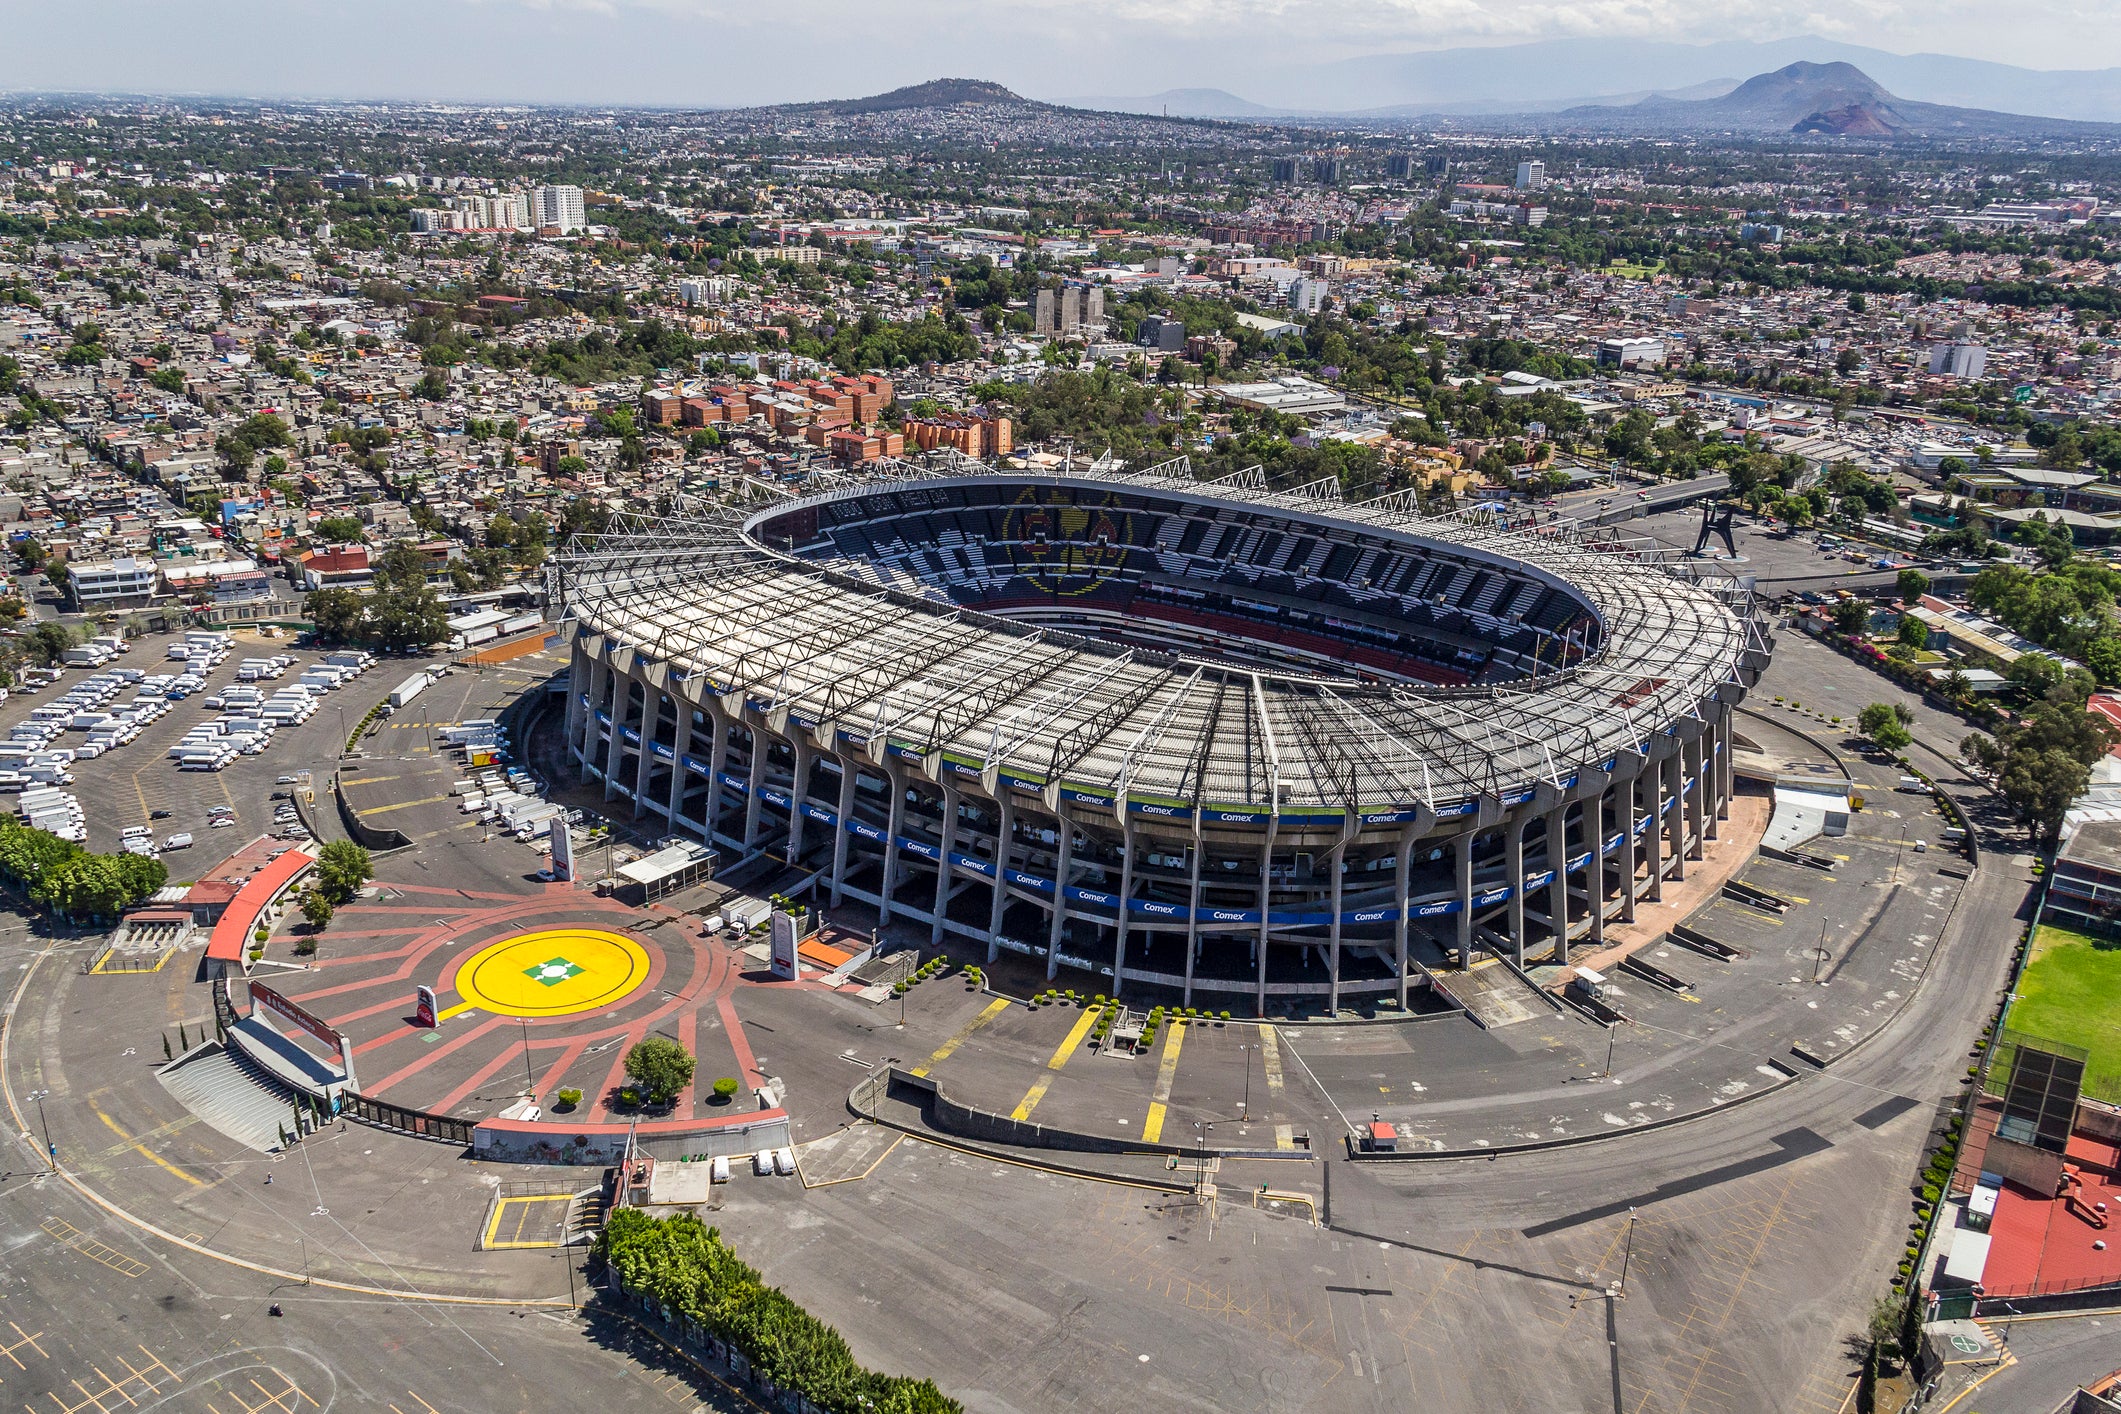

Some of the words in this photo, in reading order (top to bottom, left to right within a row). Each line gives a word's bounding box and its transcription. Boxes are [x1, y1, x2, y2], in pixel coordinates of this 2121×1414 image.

[657, 746, 674, 758] Comex
[689, 761, 706, 774] Comex
[725, 777, 744, 790] Comex
[1013, 779, 1041, 791] Comex
[765, 792, 786, 806] Comex
[1076, 793, 1106, 805] Comex
[809, 809, 831, 822] Comex
[1142, 804, 1174, 816] Comex
[1436, 806, 1464, 817] Comex
[1221, 813, 1254, 823] Comex
[1367, 813, 1399, 823] Comex
[856, 825, 879, 838] Comex
[907, 842, 931, 855] Comex
[961, 858, 987, 871] Comex
[1016, 874, 1043, 887] Comex
[1079, 890, 1108, 903] Comex
[1481, 891, 1504, 904] Comex
[1144, 903, 1175, 914] Comex
[1419, 904, 1448, 915] Comex
[1213, 911, 1246, 921] Comex
[1355, 911, 1385, 921] Comex
